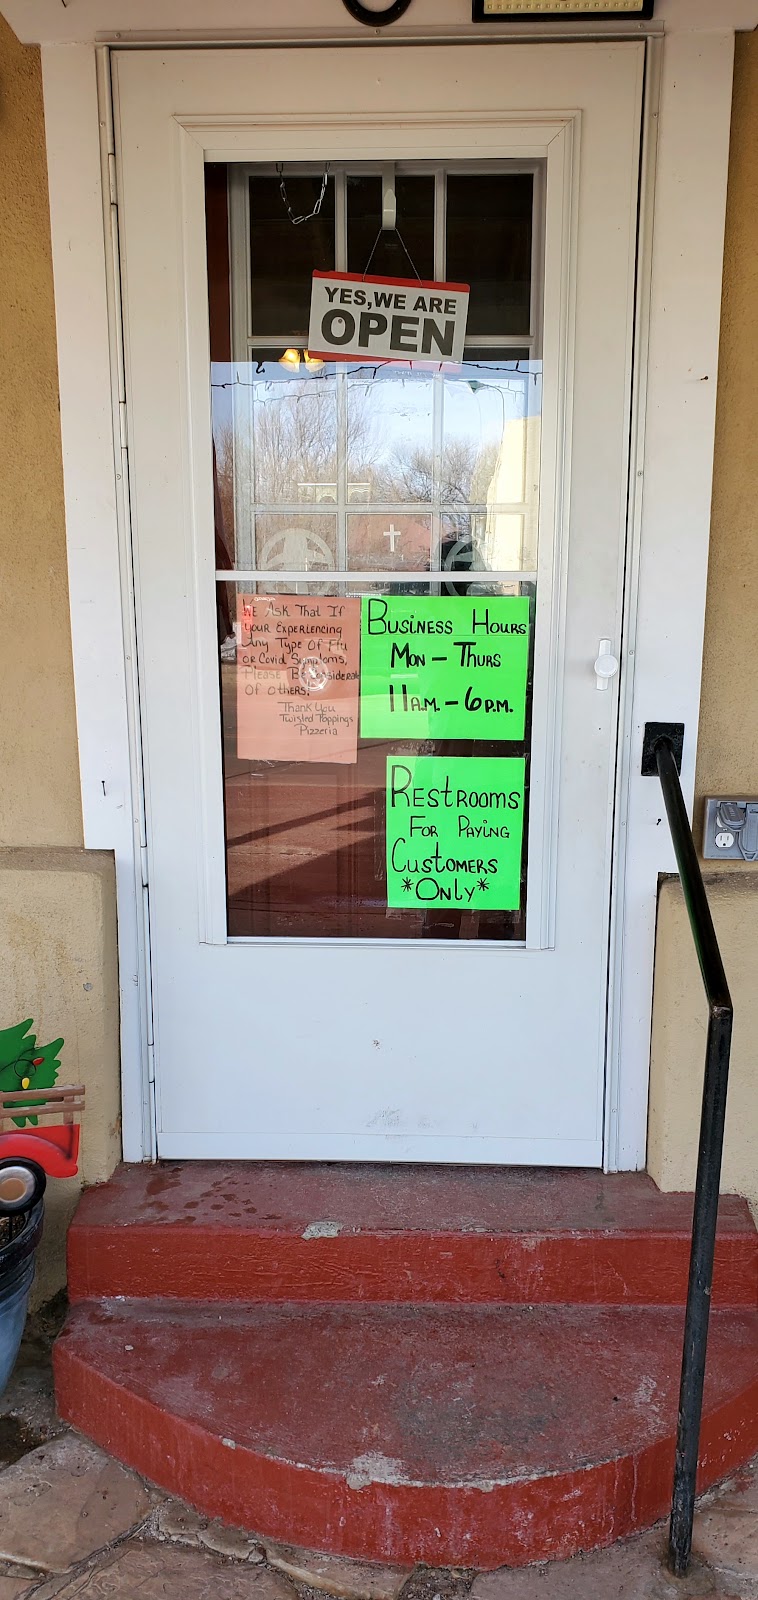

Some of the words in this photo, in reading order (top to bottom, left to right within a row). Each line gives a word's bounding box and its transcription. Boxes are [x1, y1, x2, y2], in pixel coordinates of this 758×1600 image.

[413, 296, 456, 314] ARE
[321, 308, 456, 356] OPEN
[265, 602, 290, 617] Ask
[295, 604, 320, 617] That
[328, 606, 346, 617] If
[242, 633, 269, 652] Any
[260, 652, 286, 664] Covid
[277, 702, 312, 712] Thank
[315, 702, 336, 716] You
[279, 714, 314, 723] Twisted
[316, 714, 354, 727] Toppings
[294, 724, 338, 736] Pizzeria
